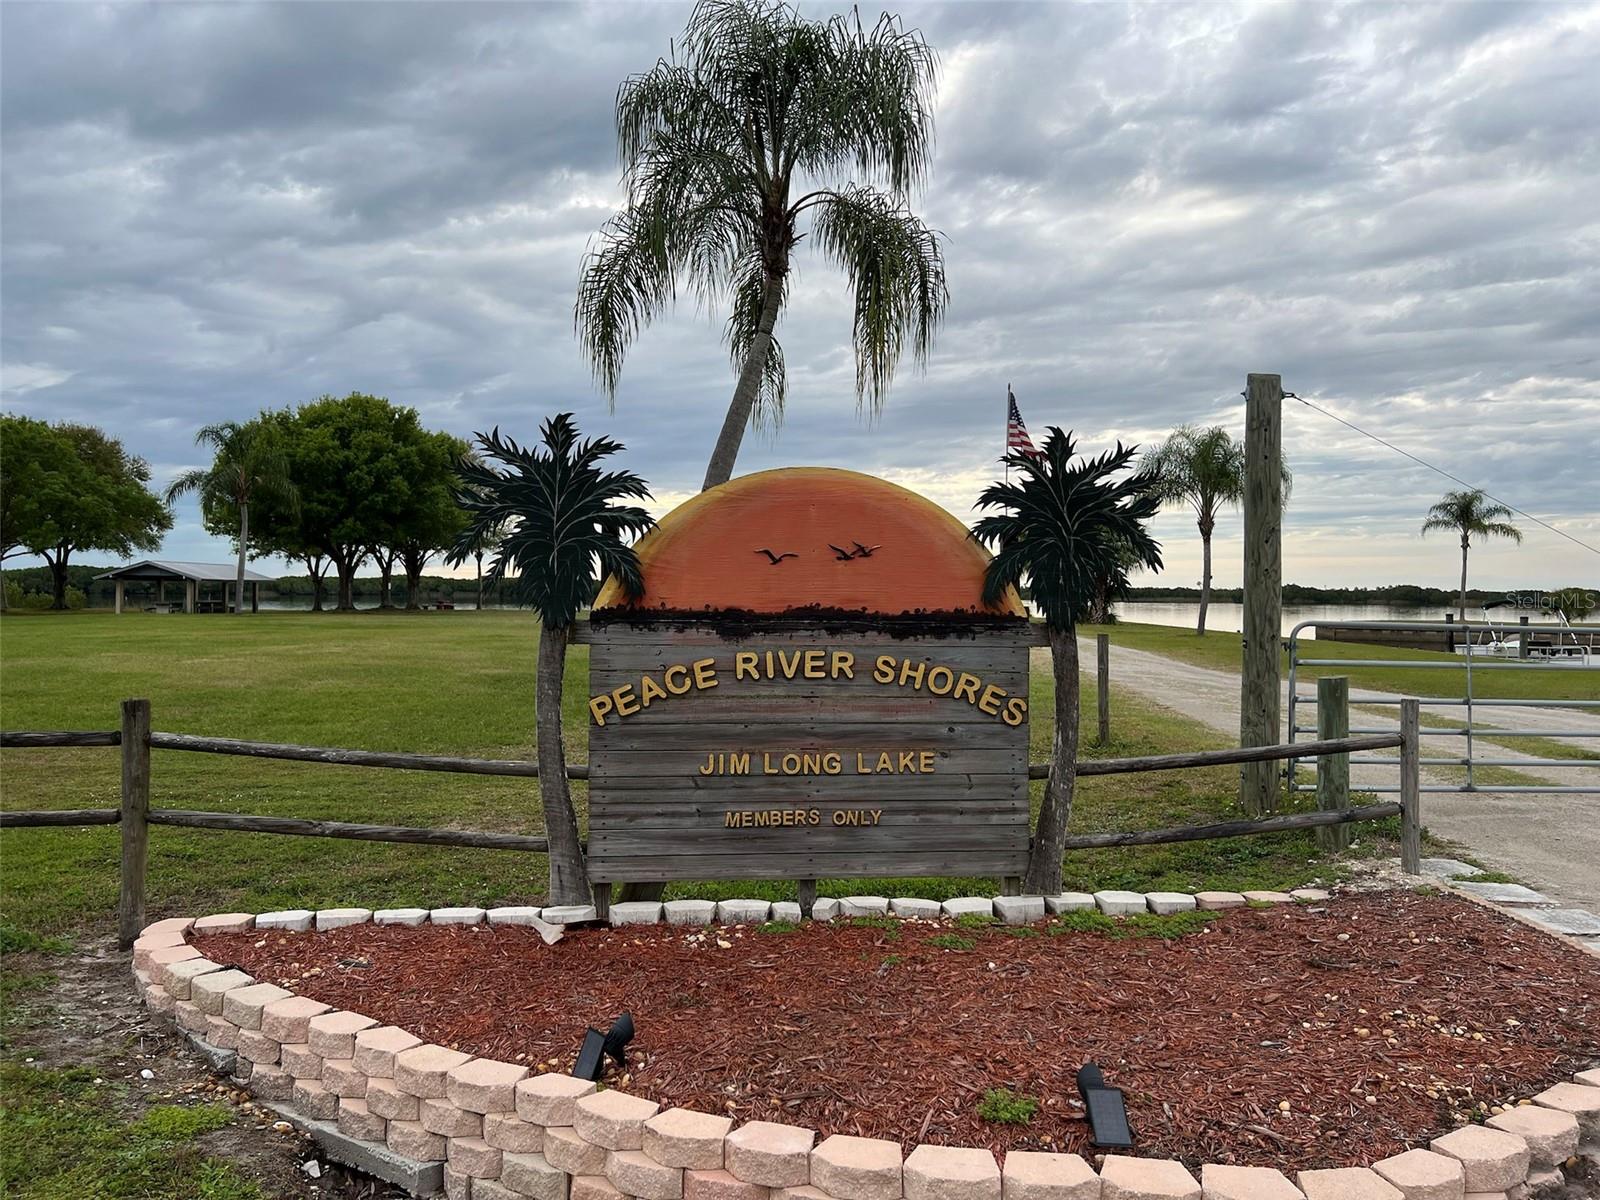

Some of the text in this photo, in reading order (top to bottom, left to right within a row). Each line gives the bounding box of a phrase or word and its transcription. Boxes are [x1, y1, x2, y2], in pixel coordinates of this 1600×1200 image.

[589, 650, 1028, 727] PEACE RIVER SHORES
[700, 751, 936, 776] JIM LONG LAKE
[724, 809, 883, 828] MEMBERS ONLY
